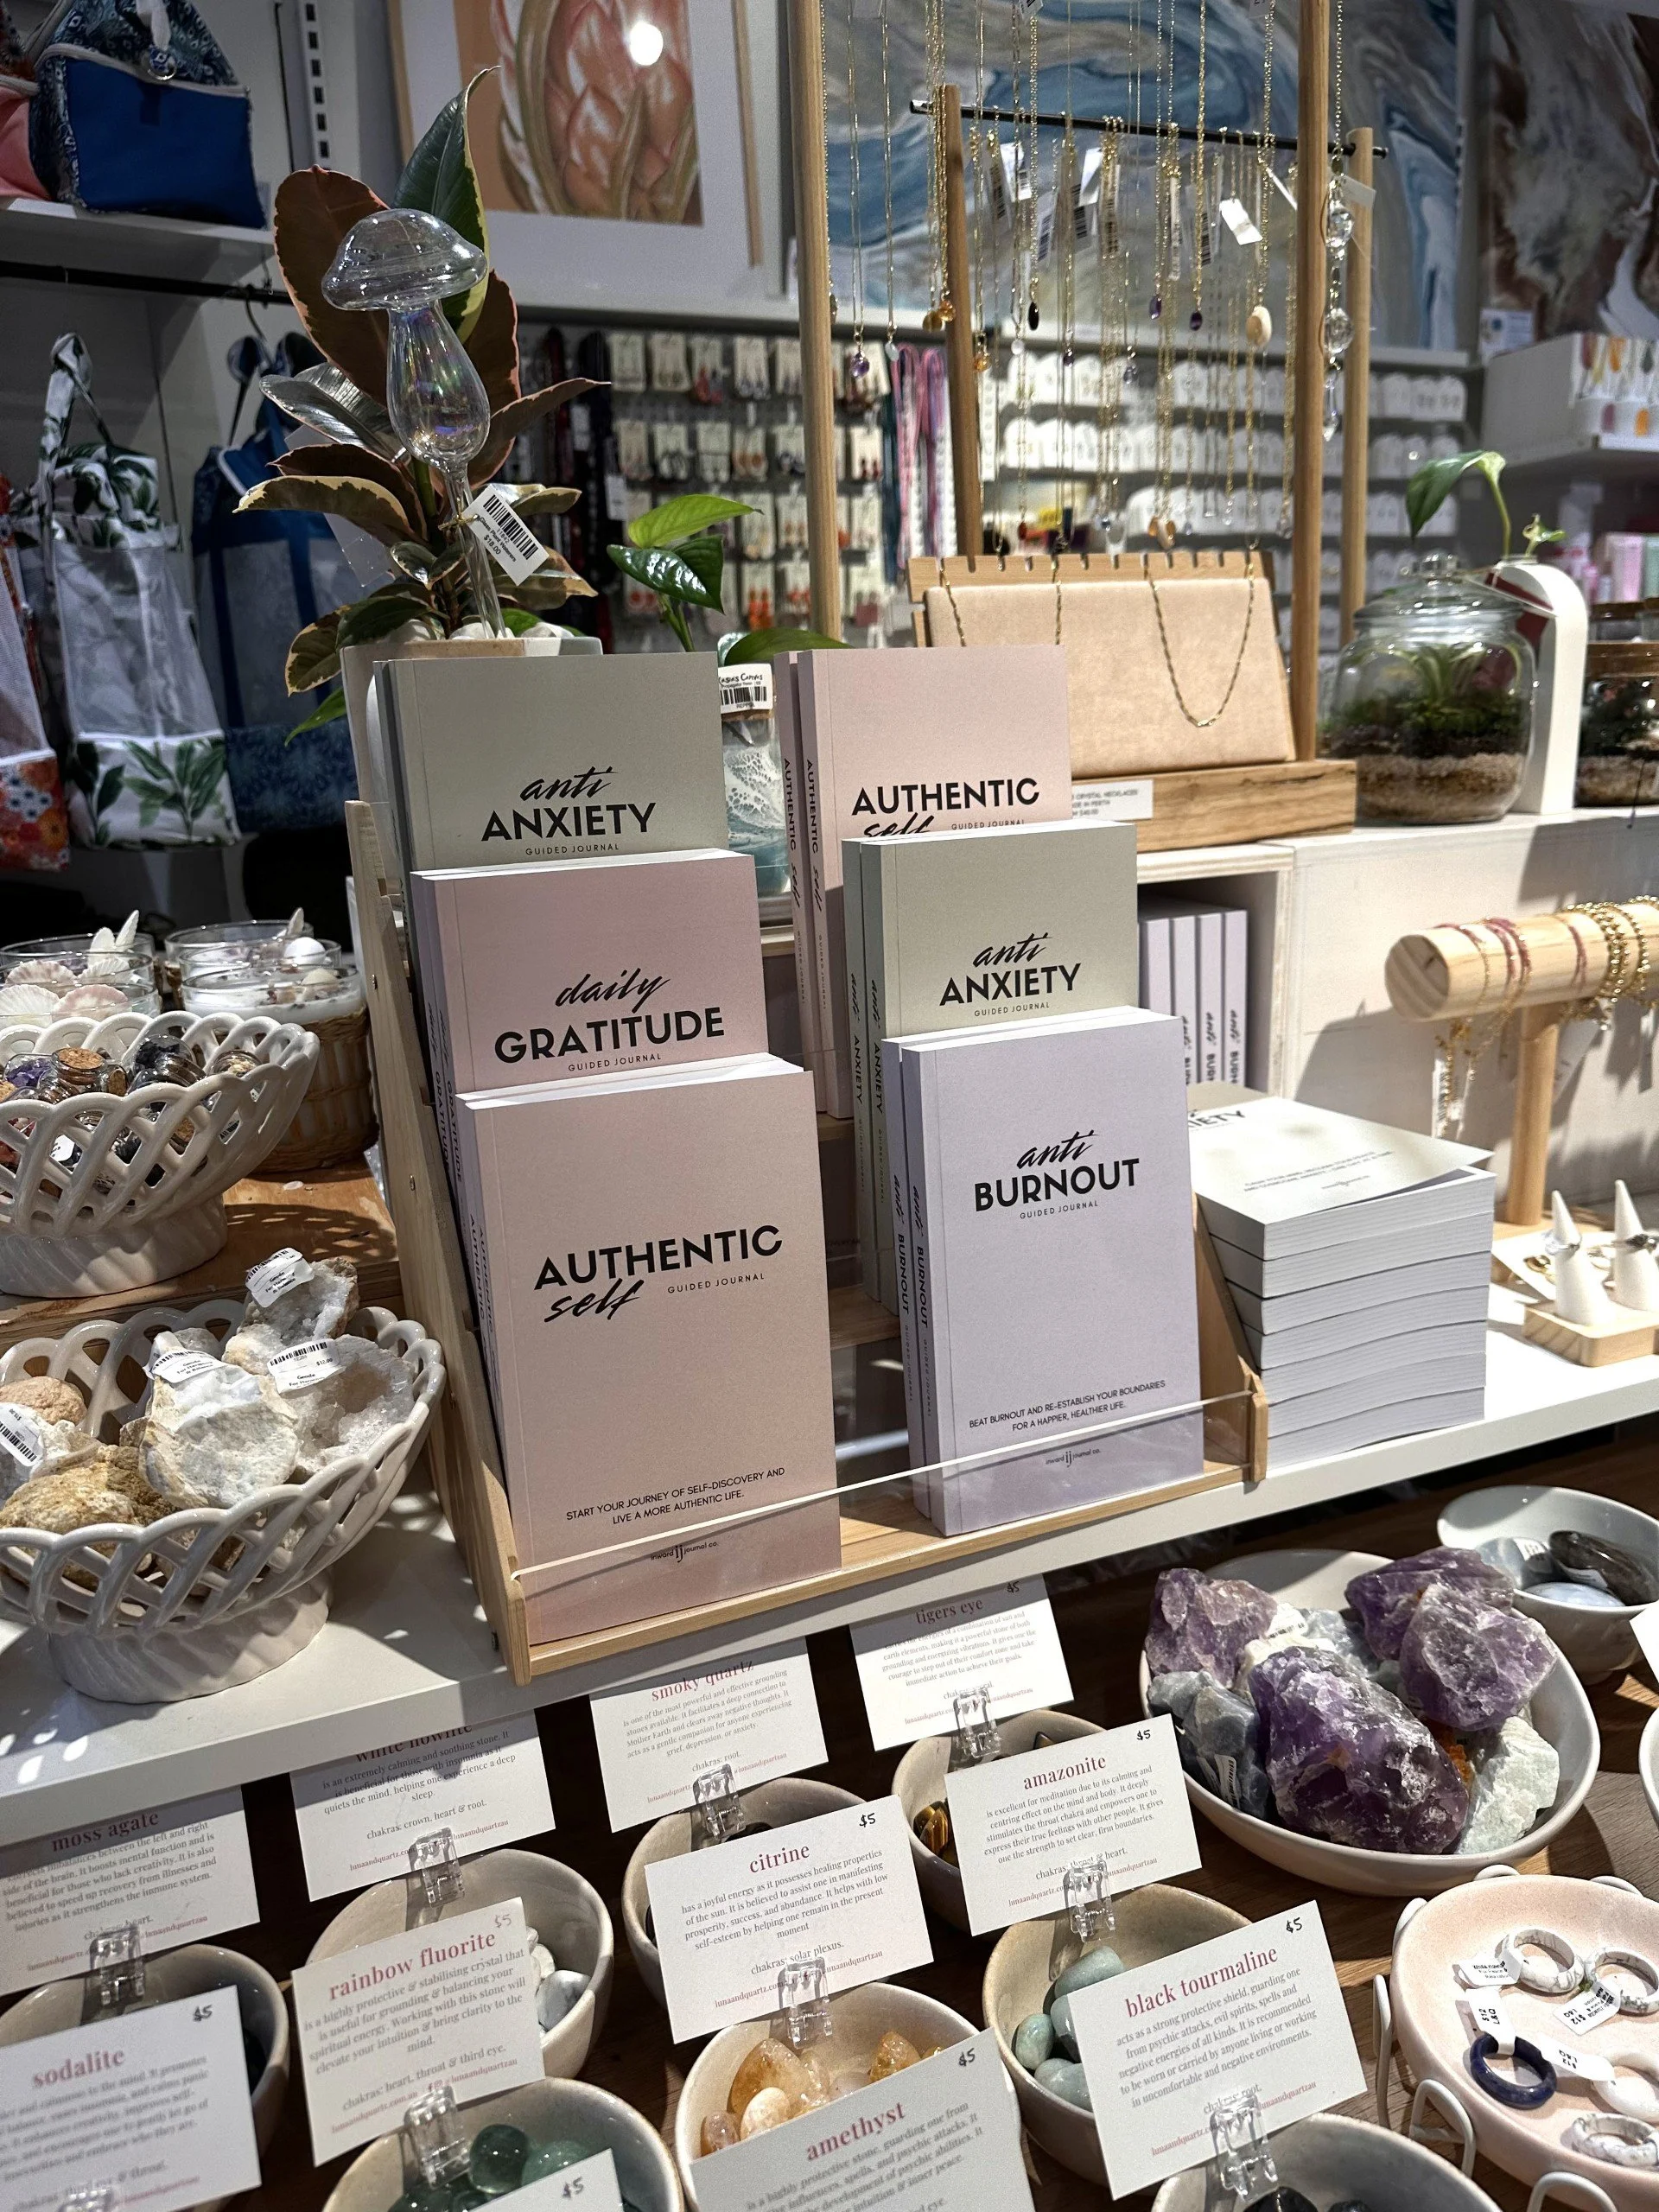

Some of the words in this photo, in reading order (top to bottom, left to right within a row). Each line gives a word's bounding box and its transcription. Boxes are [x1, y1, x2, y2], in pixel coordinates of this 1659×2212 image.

[484, 535, 502, 555] $18.00
[491, 529, 501, 543] Plant
[500, 542, 517, 563] Waterers
[519, 766, 618, 801] anti
[851, 778, 1039, 816] AUTHENTIC
[481, 803, 657, 842] ANXIETY
[784, 759, 797, 851] AUTHENTIC
[807, 760, 819, 854] AUTHENTIC
[863, 812, 935, 837] self
[951, 821, 986, 830] GUIDED
[525, 846, 568, 855] GUIDED
[572, 843, 620, 853] JOURNAL
[973, 932, 1053, 968] anti
[556, 968, 671, 1014] daily
[939, 963, 1081, 1006] ANXIETY
[975, 1007, 1008, 1017] GUIDED
[1012, 1002, 1050, 1013] JOURNAL
[494, 1007, 724, 1064] GRATITUDE
[569, 1058, 610, 1071] GUIDED
[614, 1053, 662, 1066] JOURNAL
[855, 1035, 863, 1104] ANXIETY
[874, 1042, 883, 1114] ANXIETY
[447, 1081, 462, 1183] GRATITUDE
[1188, 1110, 1246, 1128] IETY
[1016, 1129, 1098, 1169] anti
[975, 1158, 1140, 1211] BURNOUT
[1020, 1208, 1055, 1219] GUIDED
[1058, 1200, 1098, 1213] JOURNAL
[470, 1214, 485, 1319] AUTHENTIC
[533, 1224, 783, 1290] AUTHENTIC
[898, 1233, 909, 1314] BURNOUT
[480, 1224, 493, 1332] AUTHENTIC
[917, 1245, 929, 1328] BURNOUT
[543, 1278, 645, 1323] self
[667, 1281, 711, 1294] GUIDED
[715, 1273, 765, 1287] JOURNAL
[969, 1416, 988, 1427] BEAT
[989, 1408, 1025, 1423] BURNOUT
[1027, 1405, 1043, 1415] AND
[1045, 1395, 1095, 1411] RE-ESTABLISH
[1096, 1389, 1117, 1400] YOUR
[1119, 1379, 1166, 1395] BOUNDARIES
[1012, 1421, 1028, 1431] FOR
[1037, 1412, 1069, 1426] HAPPIER,
[1071, 1403, 1108, 1418] HEALTHIER
[566, 1506, 594, 1520] START
[596, 1500, 624, 1513] YOUR
[626, 1491, 669, 1508] JOURNEY
[671, 1487, 684, 1497] OF
[687, 1471, 764, 1495] SELF-DISCOVERY
[766, 1467, 785, 1478] AND
[613, 1512, 632, 1524] LIVE
[634, 1510, 641, 1519] A
[643, 1503, 671, 1517] MORE
[673, 1493, 722, 1511] AUTHENTIC
[724, 1489, 744, 1500] LIFE.
[651, 1548, 674, 1560] inward
[683, 1542, 707, 1555] journal
[1007, 1580, 1020, 1593] $5
[915, 1605, 957, 1624] tigers
[960, 1600, 983, 1615] eye
[652, 1674, 702, 1701] smoky
[705, 1660, 754, 1688] quartz
[1136, 1730, 1151, 1741] $5
[1023, 1757, 1105, 1789] amazonite
[434, 1808, 456, 1820] heart
[458, 1804, 465, 1813] &
[860, 1813, 876, 1827] $5
[51, 1828, 102, 1852] moss
[108, 1812, 159, 1838] agate
[749, 1846, 809, 1872] citrine
[681, 1904, 696, 1914] has
[703, 1893, 726, 1908] joyful
[728, 1887, 753, 1899] energy
[766, 1880, 773, 1889] it
[774, 1870, 812, 1888] possesses
[813, 1861, 842, 1875] healing
[842, 1850, 882, 1867] properties
[685, 1916, 694, 1925] of
[695, 1913, 709, 1923] the
[728, 1904, 735, 1913] It
[736, 1902, 744, 1910] is
[745, 1891, 778, 1908] believed
[790, 1882, 811, 1894] assist
[812, 1878, 827, 1888] one
[829, 1875, 837, 1884] in
[838, 1862, 883, 1880] manifesting
[730, 1911, 762, 1925] success,
[764, 1904, 779, 1916] and
[833, 1884, 855, 1895] helps
[855, 1877, 873, 1888] with
[874, 1873, 887, 1883] low
[494, 1914, 512, 1928] $5
[695, 1930, 741, 1950] self-esteem
[742, 1927, 752, 1936] by
[753, 1917, 784, 1932] helping
[785, 1913, 799, 1922] one
[801, 1904, 829, 1917] remain
[840, 1897, 852, 1906] the
[854, 1887, 883, 1904] present
[776, 1922, 809, 1938] moment
[1286, 1917, 1302, 1933] $5
[329, 1961, 410, 2000] rainbow
[420, 1934, 494, 1967] fluorite
[1125, 1983, 1176, 2018] black
[1179, 1948, 1277, 1996] tourmaline
[193, 2005, 213, 2022] $5
[32, 2048, 125, 2088] sodalite
[958, 2048, 976, 2067] $5
[806, 2101, 906, 2161] amethyst
[562, 2177, 584, 2200] $5
